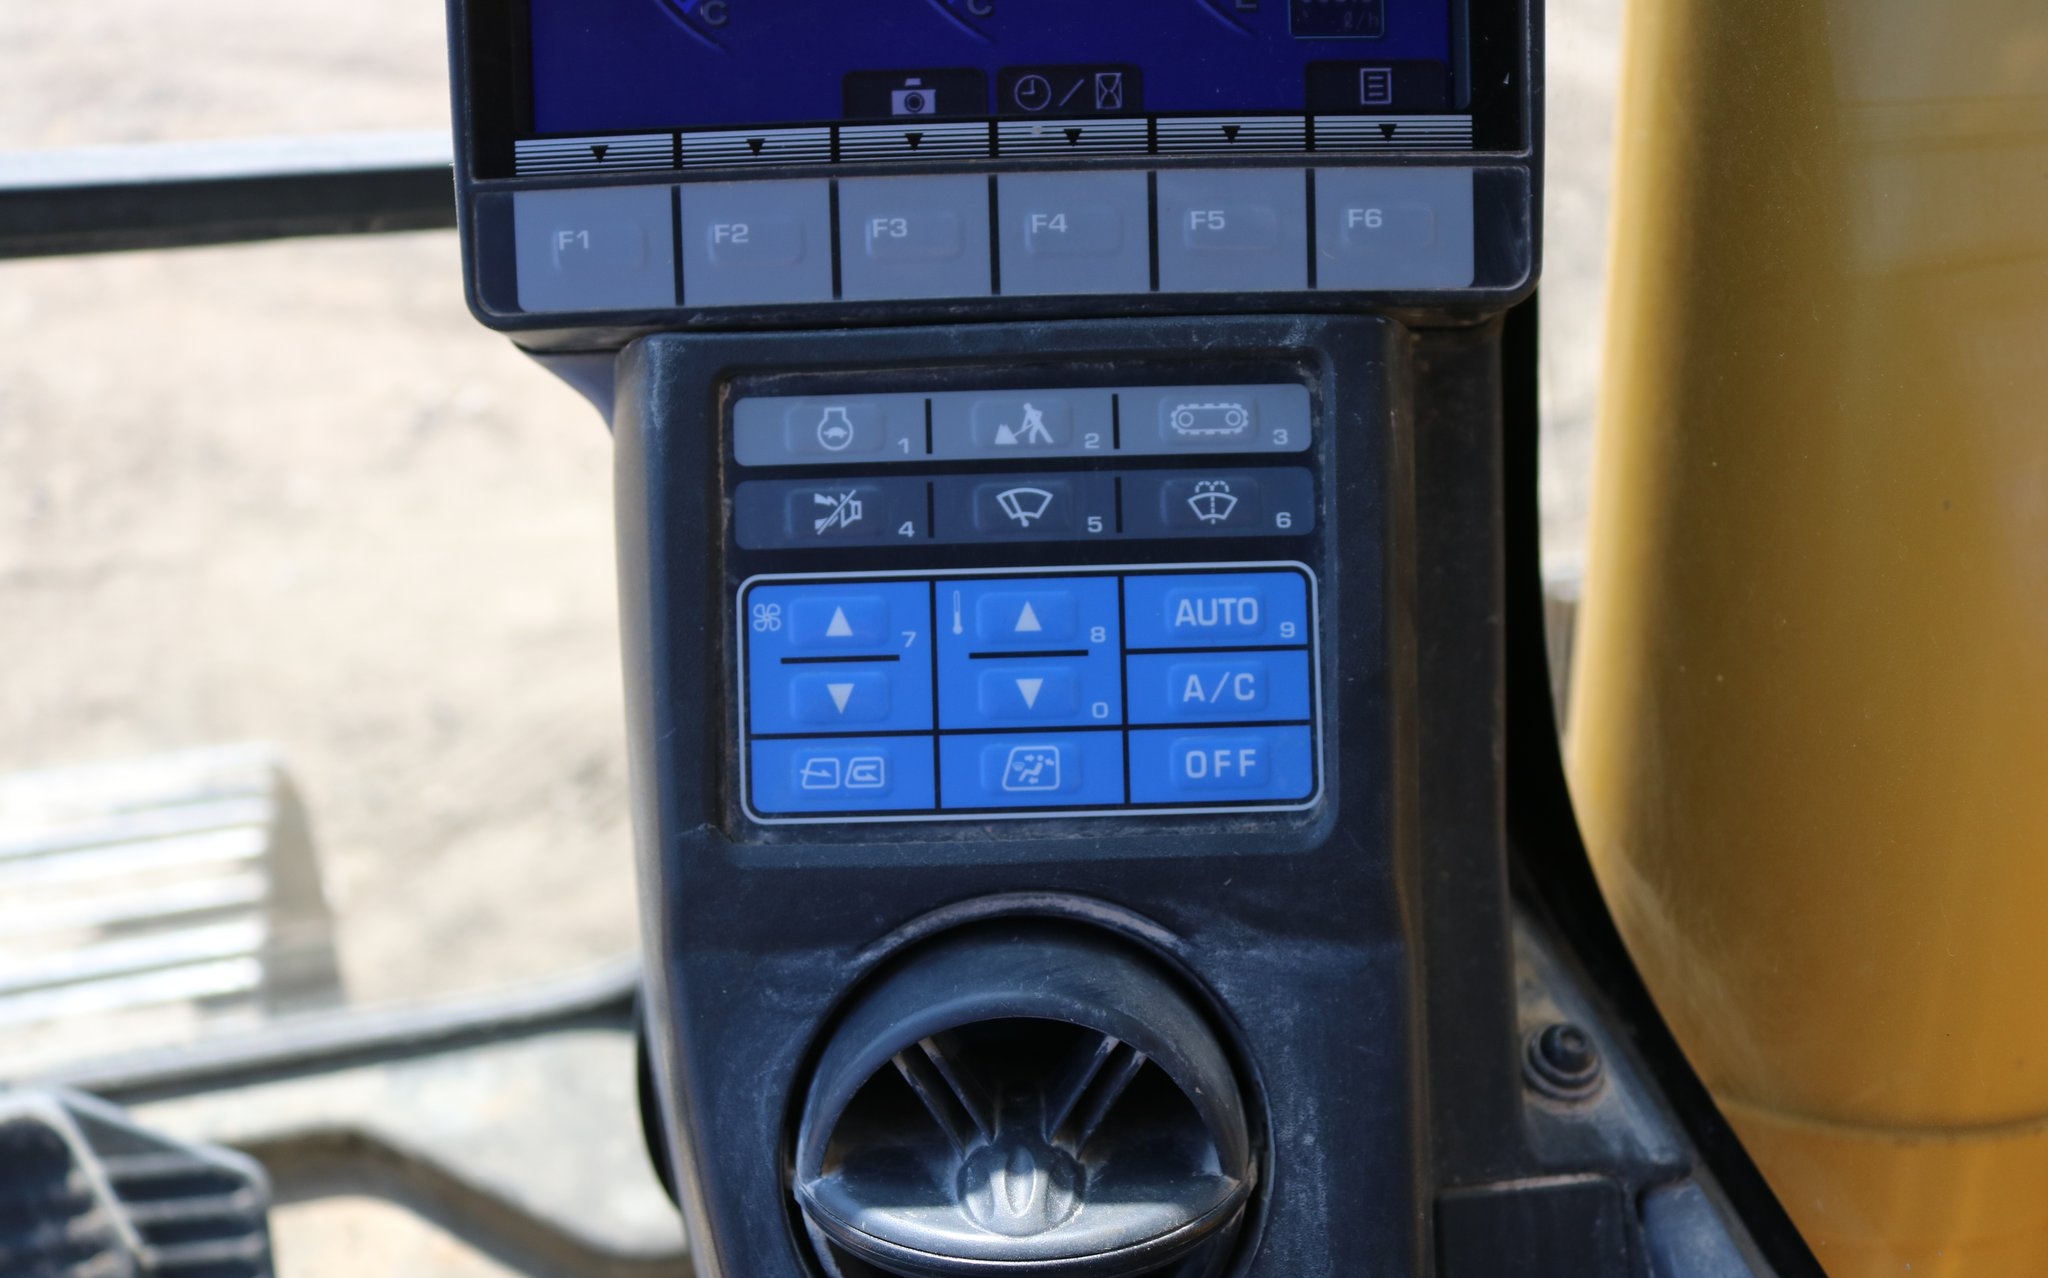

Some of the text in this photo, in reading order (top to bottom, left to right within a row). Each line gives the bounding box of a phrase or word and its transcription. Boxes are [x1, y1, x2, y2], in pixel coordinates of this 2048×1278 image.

[703, 0, 728, 25] C
[872, 217, 908, 238] F3
[1031, 213, 1068, 234] F4
[1189, 210, 1226, 230] F5
[1347, 208, 1383, 229] F6
[557, 229, 589, 251] F1
[713, 223, 749, 244] F2
[897, 437, 909, 454] 1
[1084, 432, 1100, 450] 2
[1272, 428, 1289, 446] 3
[898, 520, 915, 538] 4
[1087, 516, 1103, 533] 5
[1275, 511, 1292, 529] 6
[1175, 597, 1259, 627] AUTO
[901, 630, 917, 648] 7
[1090, 626, 1107, 644] 8
[1279, 621, 1296, 639] 9
[1183, 671, 1255, 703] A/C
[1091, 701, 1109, 719] 0
[1185, 748, 1256, 779] OFF
